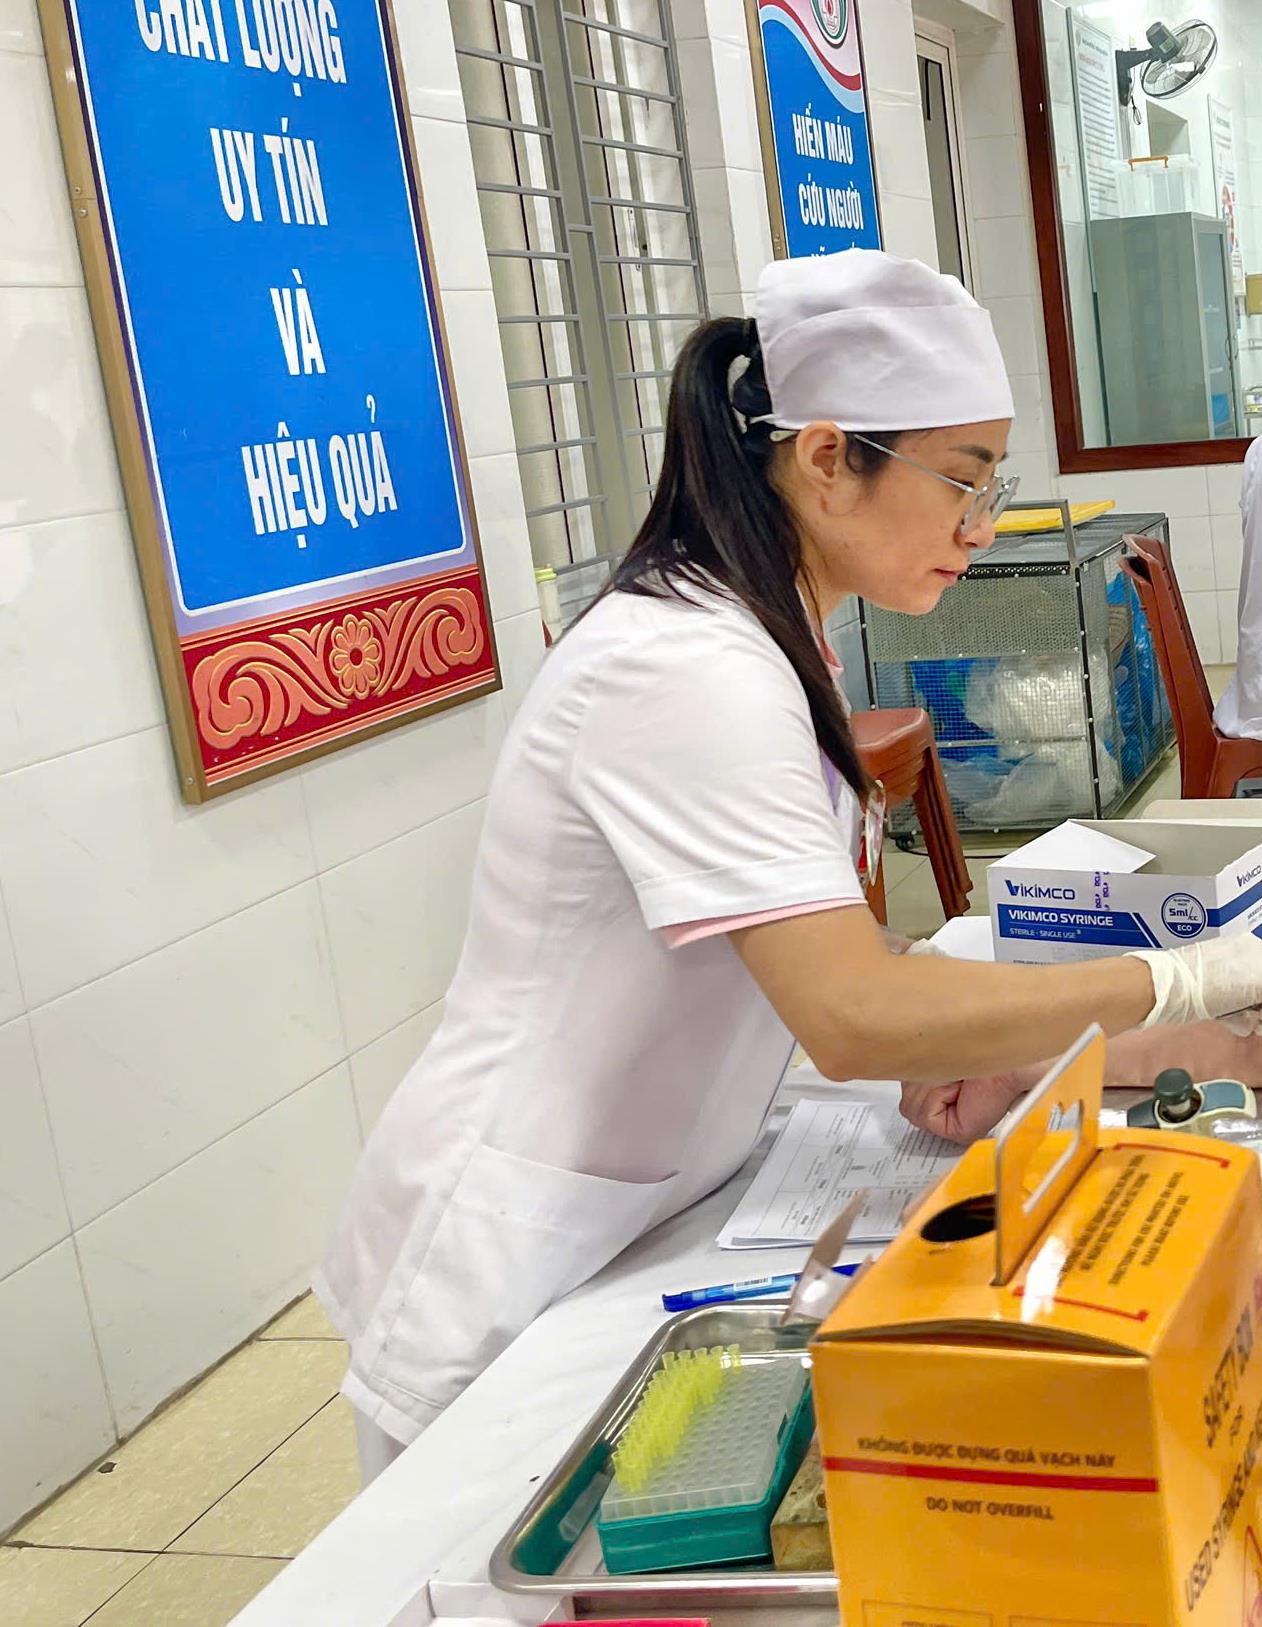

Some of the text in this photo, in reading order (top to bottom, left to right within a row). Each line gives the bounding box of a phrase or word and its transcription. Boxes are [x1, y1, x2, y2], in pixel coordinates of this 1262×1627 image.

[792, 103, 854, 165] HIẾN MÁU
[210, 117, 328, 226] UY TÍN
[798, 173, 864, 230] CỨU NGƯỜI
[270, 268, 326, 375] VÀ
[241, 394, 397, 548] HIỆU QUẢ
[1008, 909, 1114, 926] VIKIMCO SYRINGE
[1009, 927, 1077, 939] STERILE SINGLE USE
[1177, 924, 1192, 932] ECO
[858, 1435, 909, 1455] KHÔNG
[912, 1441, 954, 1459] ĐƯỢC
[926, 1496, 1054, 1520] DO NOT OVERFILL
